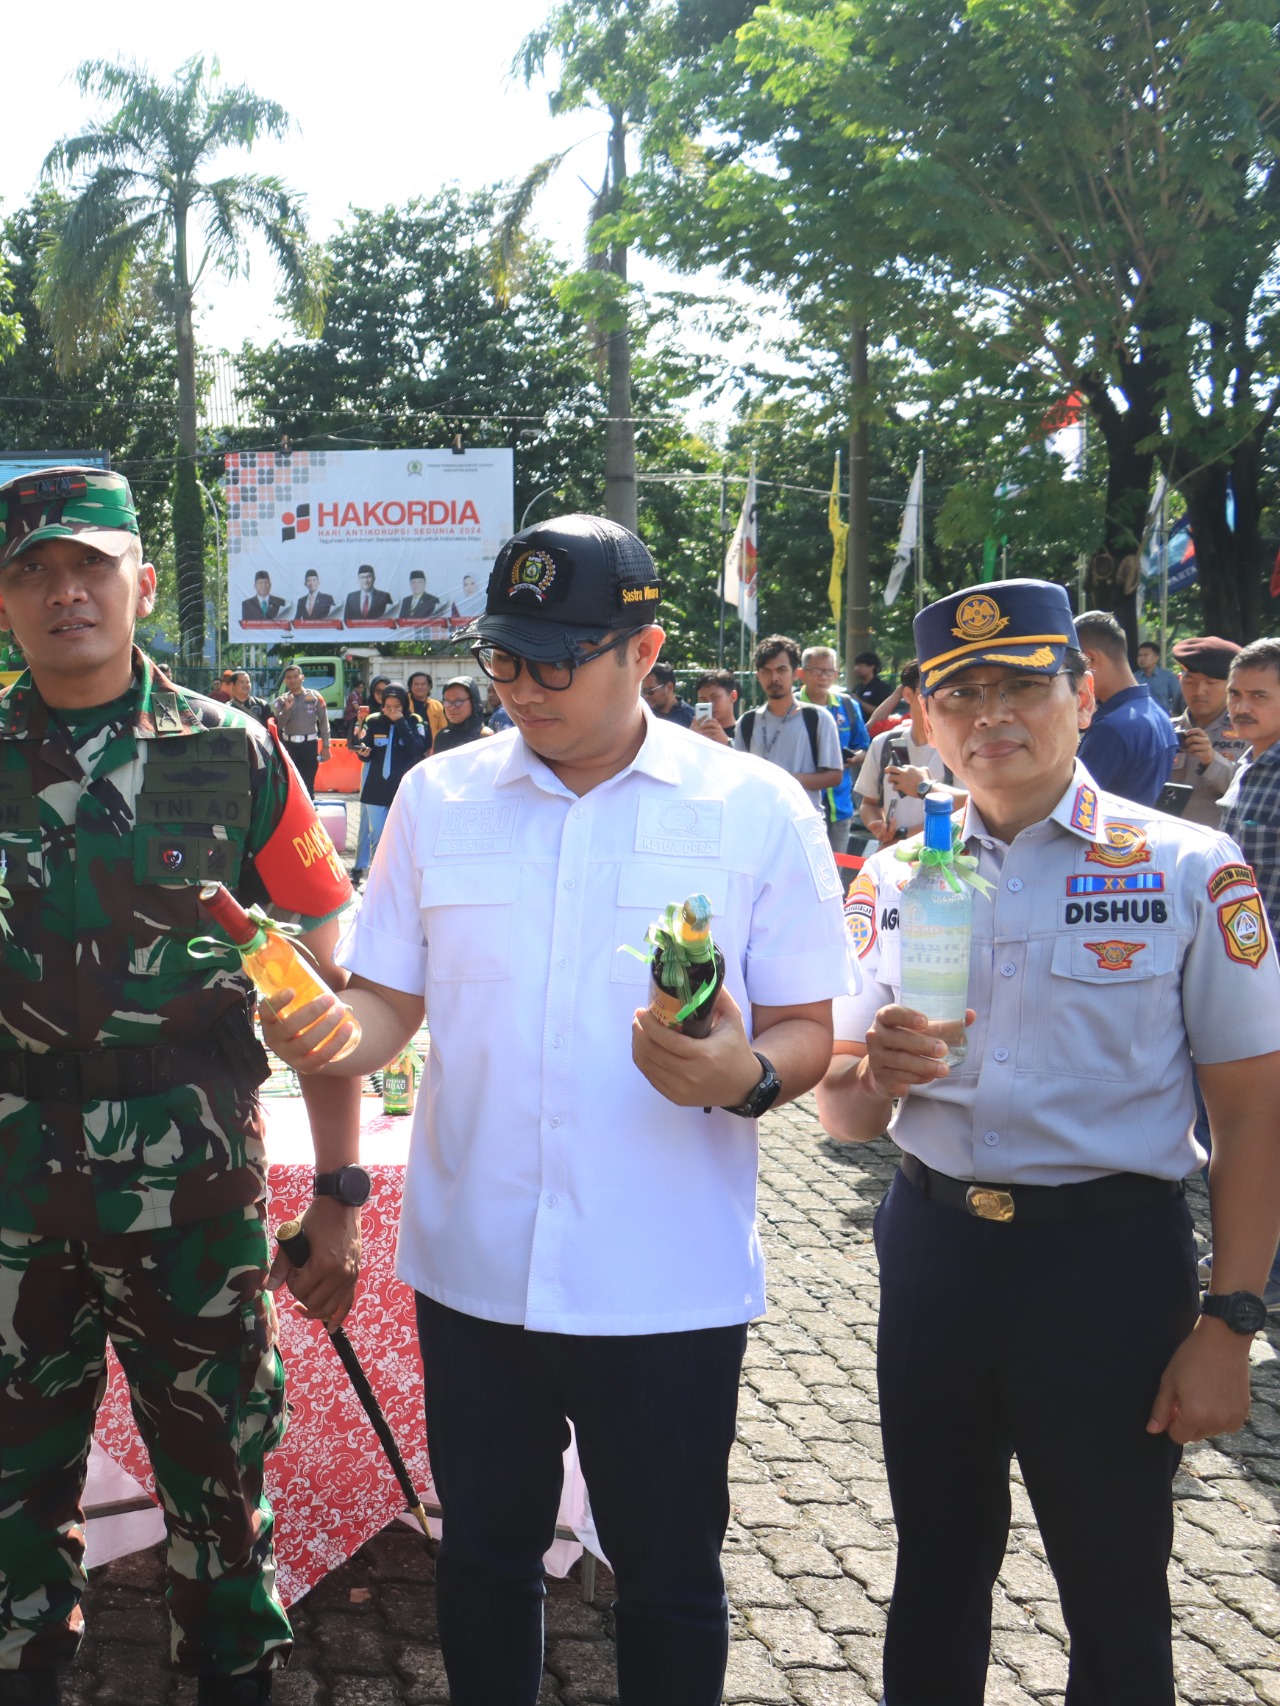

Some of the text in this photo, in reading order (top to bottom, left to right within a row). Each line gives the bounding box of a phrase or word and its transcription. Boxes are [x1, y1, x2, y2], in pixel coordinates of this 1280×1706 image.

[318, 500, 480, 527] HAKORDIA
[318, 526, 481, 537] HARI ANTIKORUPSI SEDUNIA 2024
[623, 588, 643, 604] Sastra
[1213, 741, 1245, 749] POLRI
[150, 798, 240, 820] TNI AD
[444, 805, 513, 835] DPRD
[449, 838, 498, 851] SASTRA
[642, 838, 714, 855] KETUA DPRD
[881, 908, 900, 931] AG
[1065, 899, 1168, 925] DISHUB
